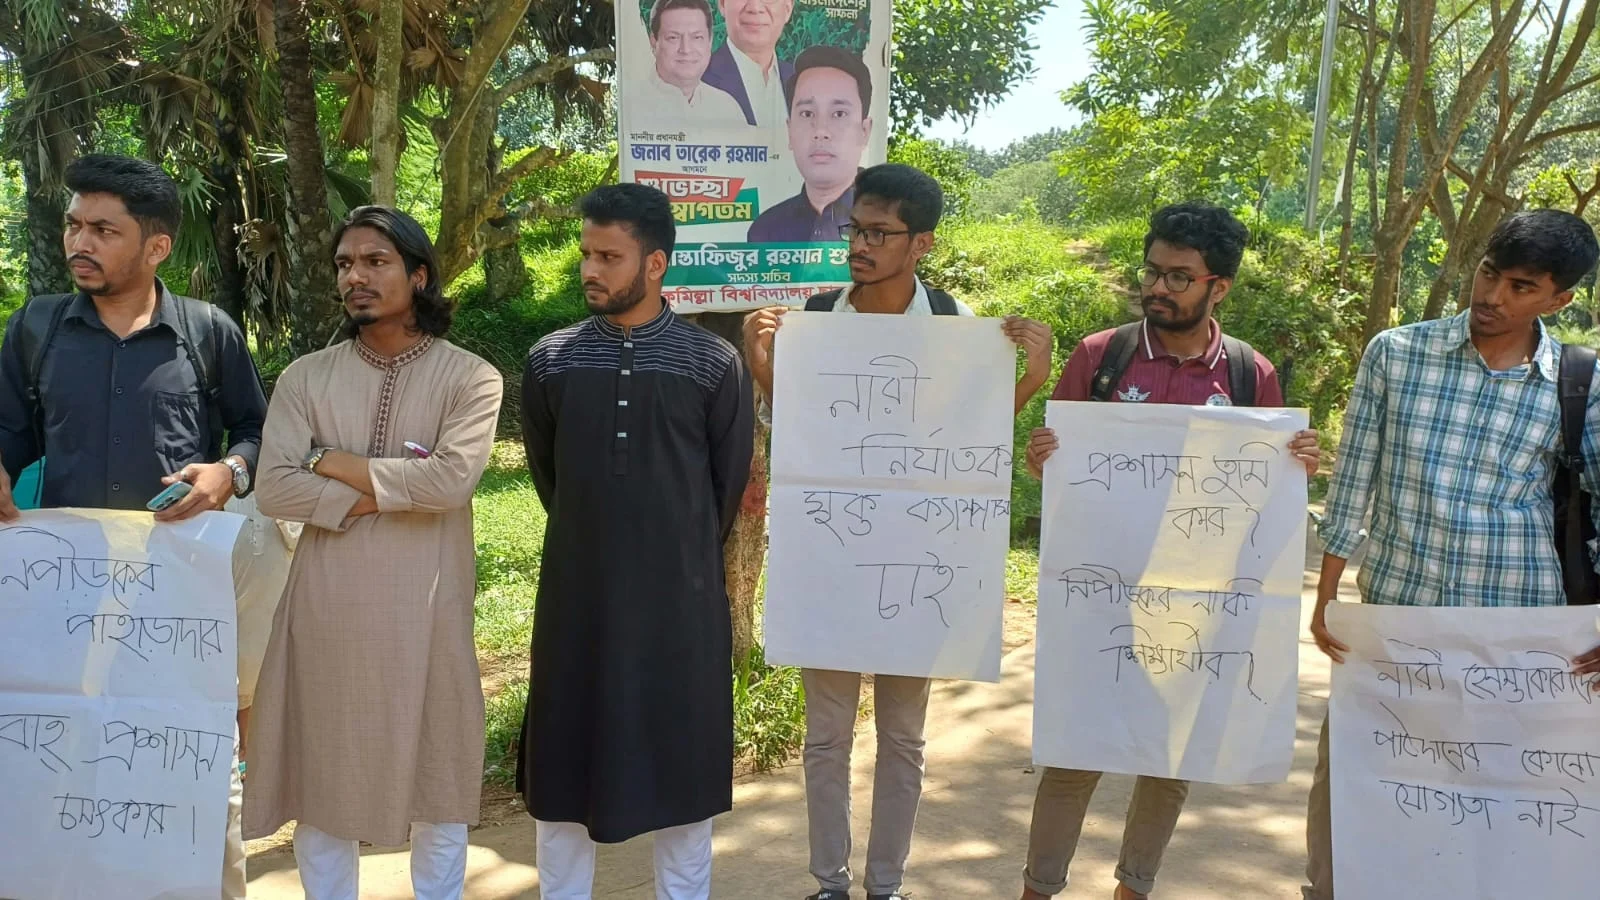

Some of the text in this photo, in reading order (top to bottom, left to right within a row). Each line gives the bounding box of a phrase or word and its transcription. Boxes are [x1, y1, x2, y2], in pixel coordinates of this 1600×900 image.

[630, 131, 686, 142] মাননীয় প্রধানমন্ত্রী
[630, 143, 671, 162] জনাব
[675, 144, 722, 164] তারেক
[725, 145, 768, 163] রহমান
[682, 165, 707, 174] আগমনে
[670, 202, 752, 222] স্বাগতম
[766, 248, 824, 266] রহমান
[720, 285, 815, 304] বিশ্ববিদ্যালয়
[727, 269, 791, 284] সদস্য সচিব
[818, 355, 932, 422] নারী
[1069, 442, 1279, 506] প্রশাসন তুমি
[856, 552, 967, 628] চাই
[1192, 577, 1264, 617] নাকি
[1374, 638, 1444, 699] নারী
[81, 720, 235, 781] প্রশাসন
[1521, 749, 1600, 783] কোনো
[53, 792, 177, 840] চমৎকার
[1515, 786, 1600, 838] নাই
